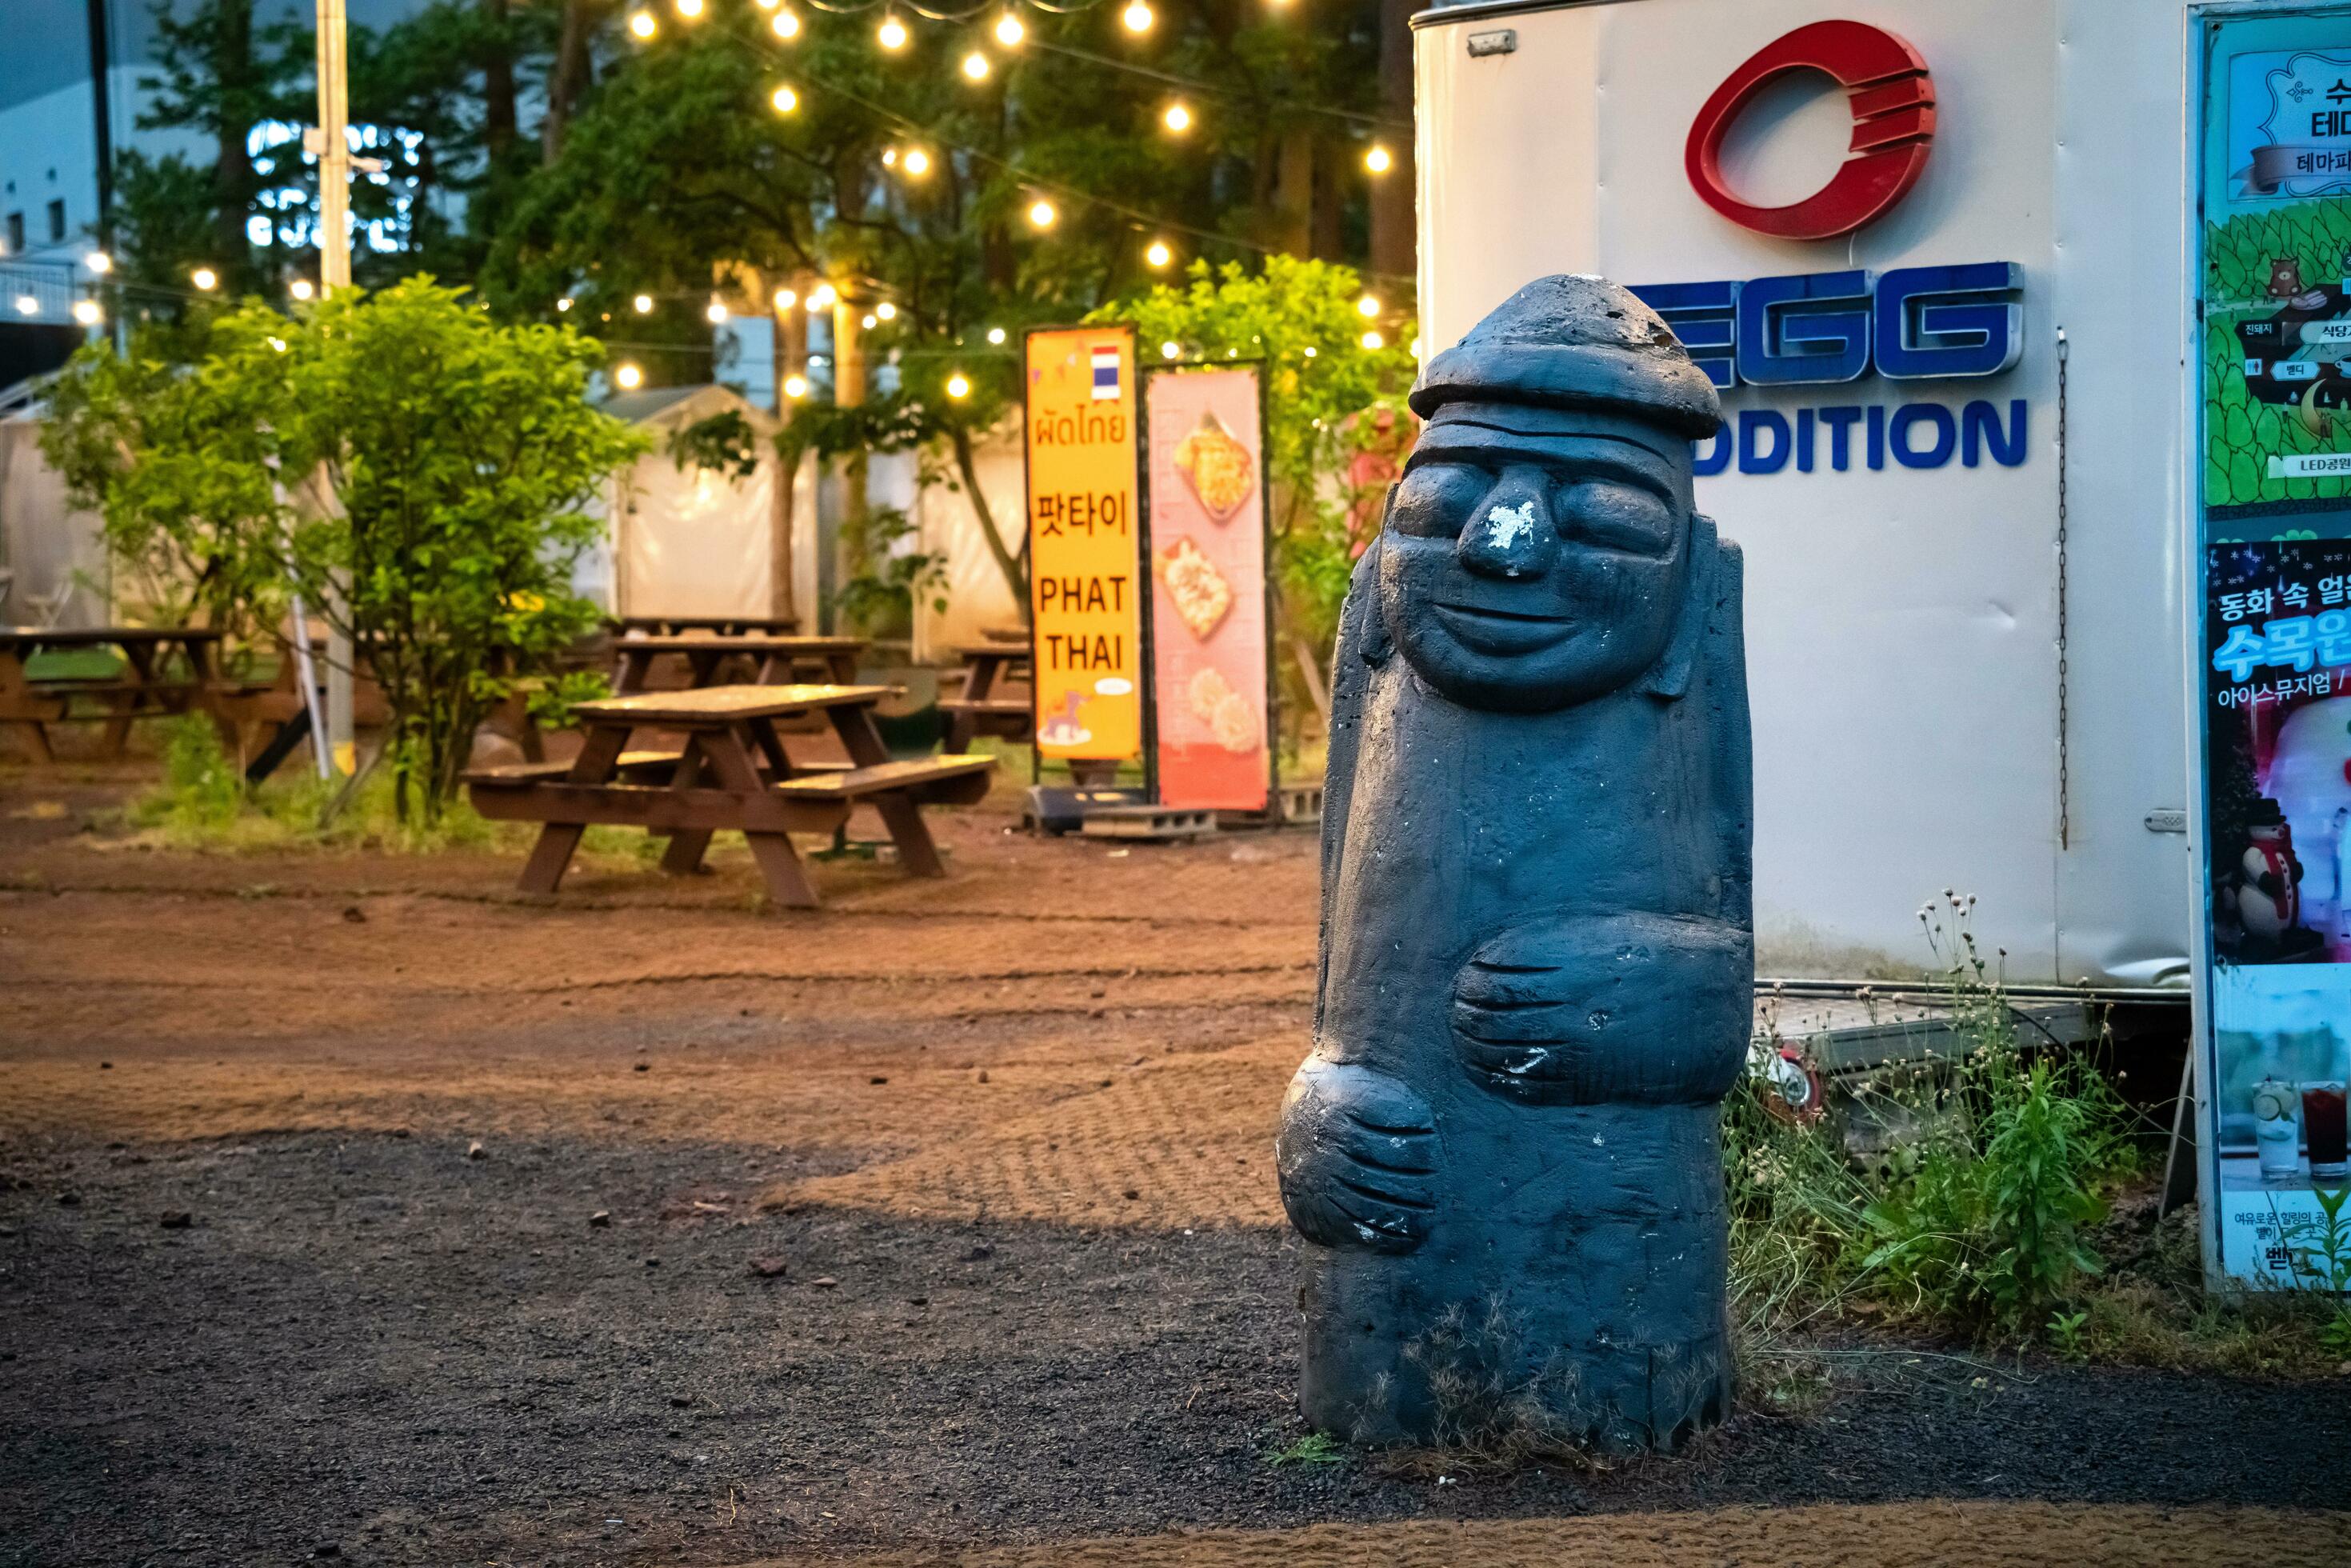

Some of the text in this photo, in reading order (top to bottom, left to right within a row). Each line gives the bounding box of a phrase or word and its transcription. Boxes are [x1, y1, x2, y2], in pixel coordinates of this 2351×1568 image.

[2322, 325, 2351, 338] 식당
[1038, 490, 1126, 537] 팟타이
[1041, 576, 1126, 612] PHAT
[2219, 575, 2351, 622] 동화 속 얼
[1046, 634, 1122, 670] THAI
[2217, 671, 2331, 709] 아이스뮤지엄
[2234, 1211, 2330, 1226] 여유로운 힐링의 공
